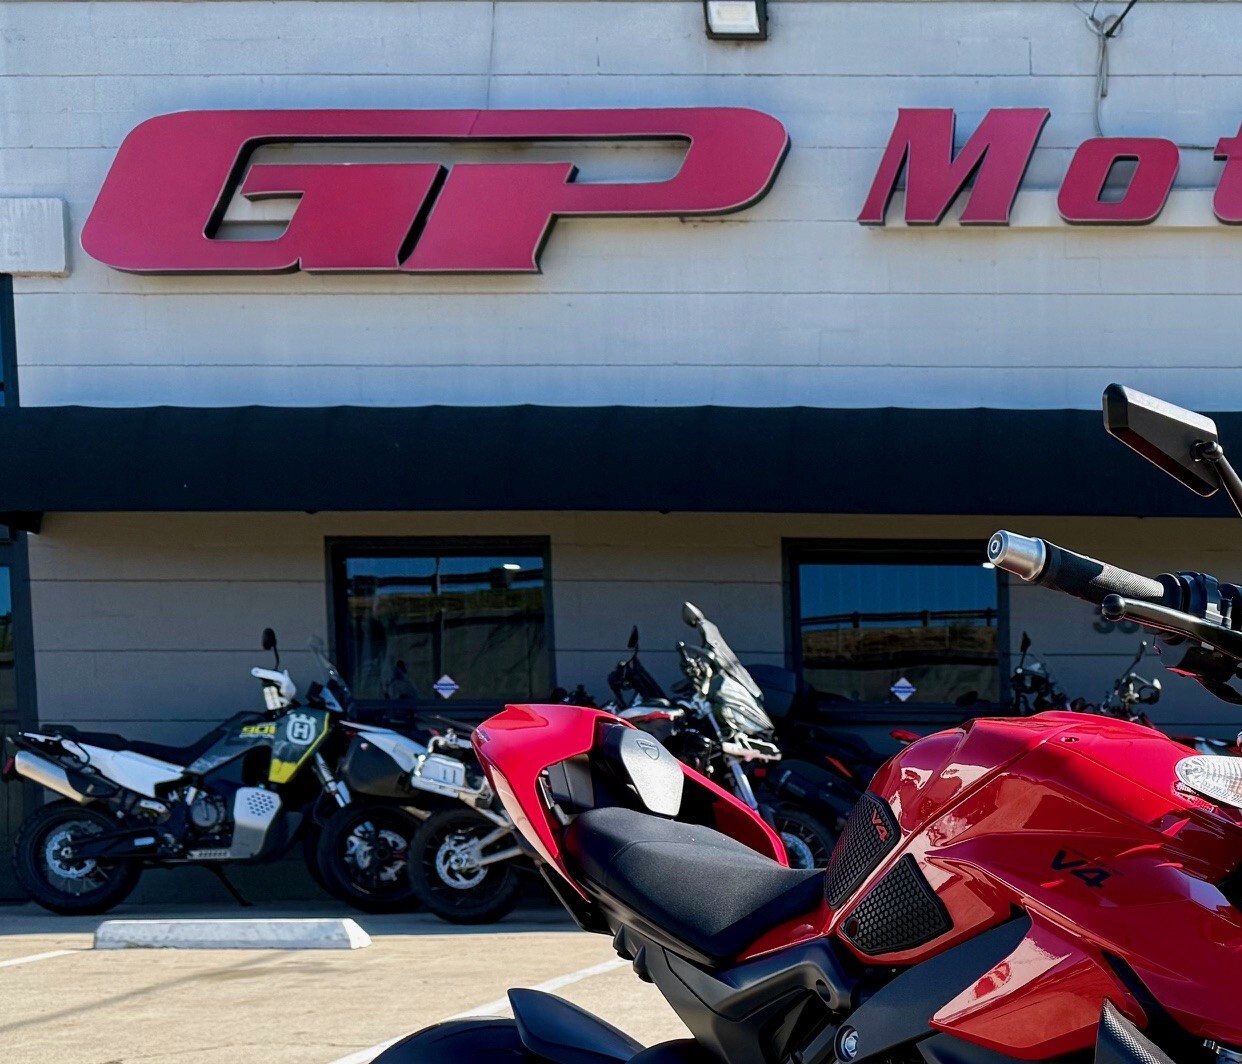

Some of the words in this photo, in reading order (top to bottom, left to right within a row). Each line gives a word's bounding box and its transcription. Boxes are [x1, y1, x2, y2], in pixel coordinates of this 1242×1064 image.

[81, 106, 791, 275] GP
[871, 807, 888, 842] V4
[1051, 849, 1112, 888] V4
